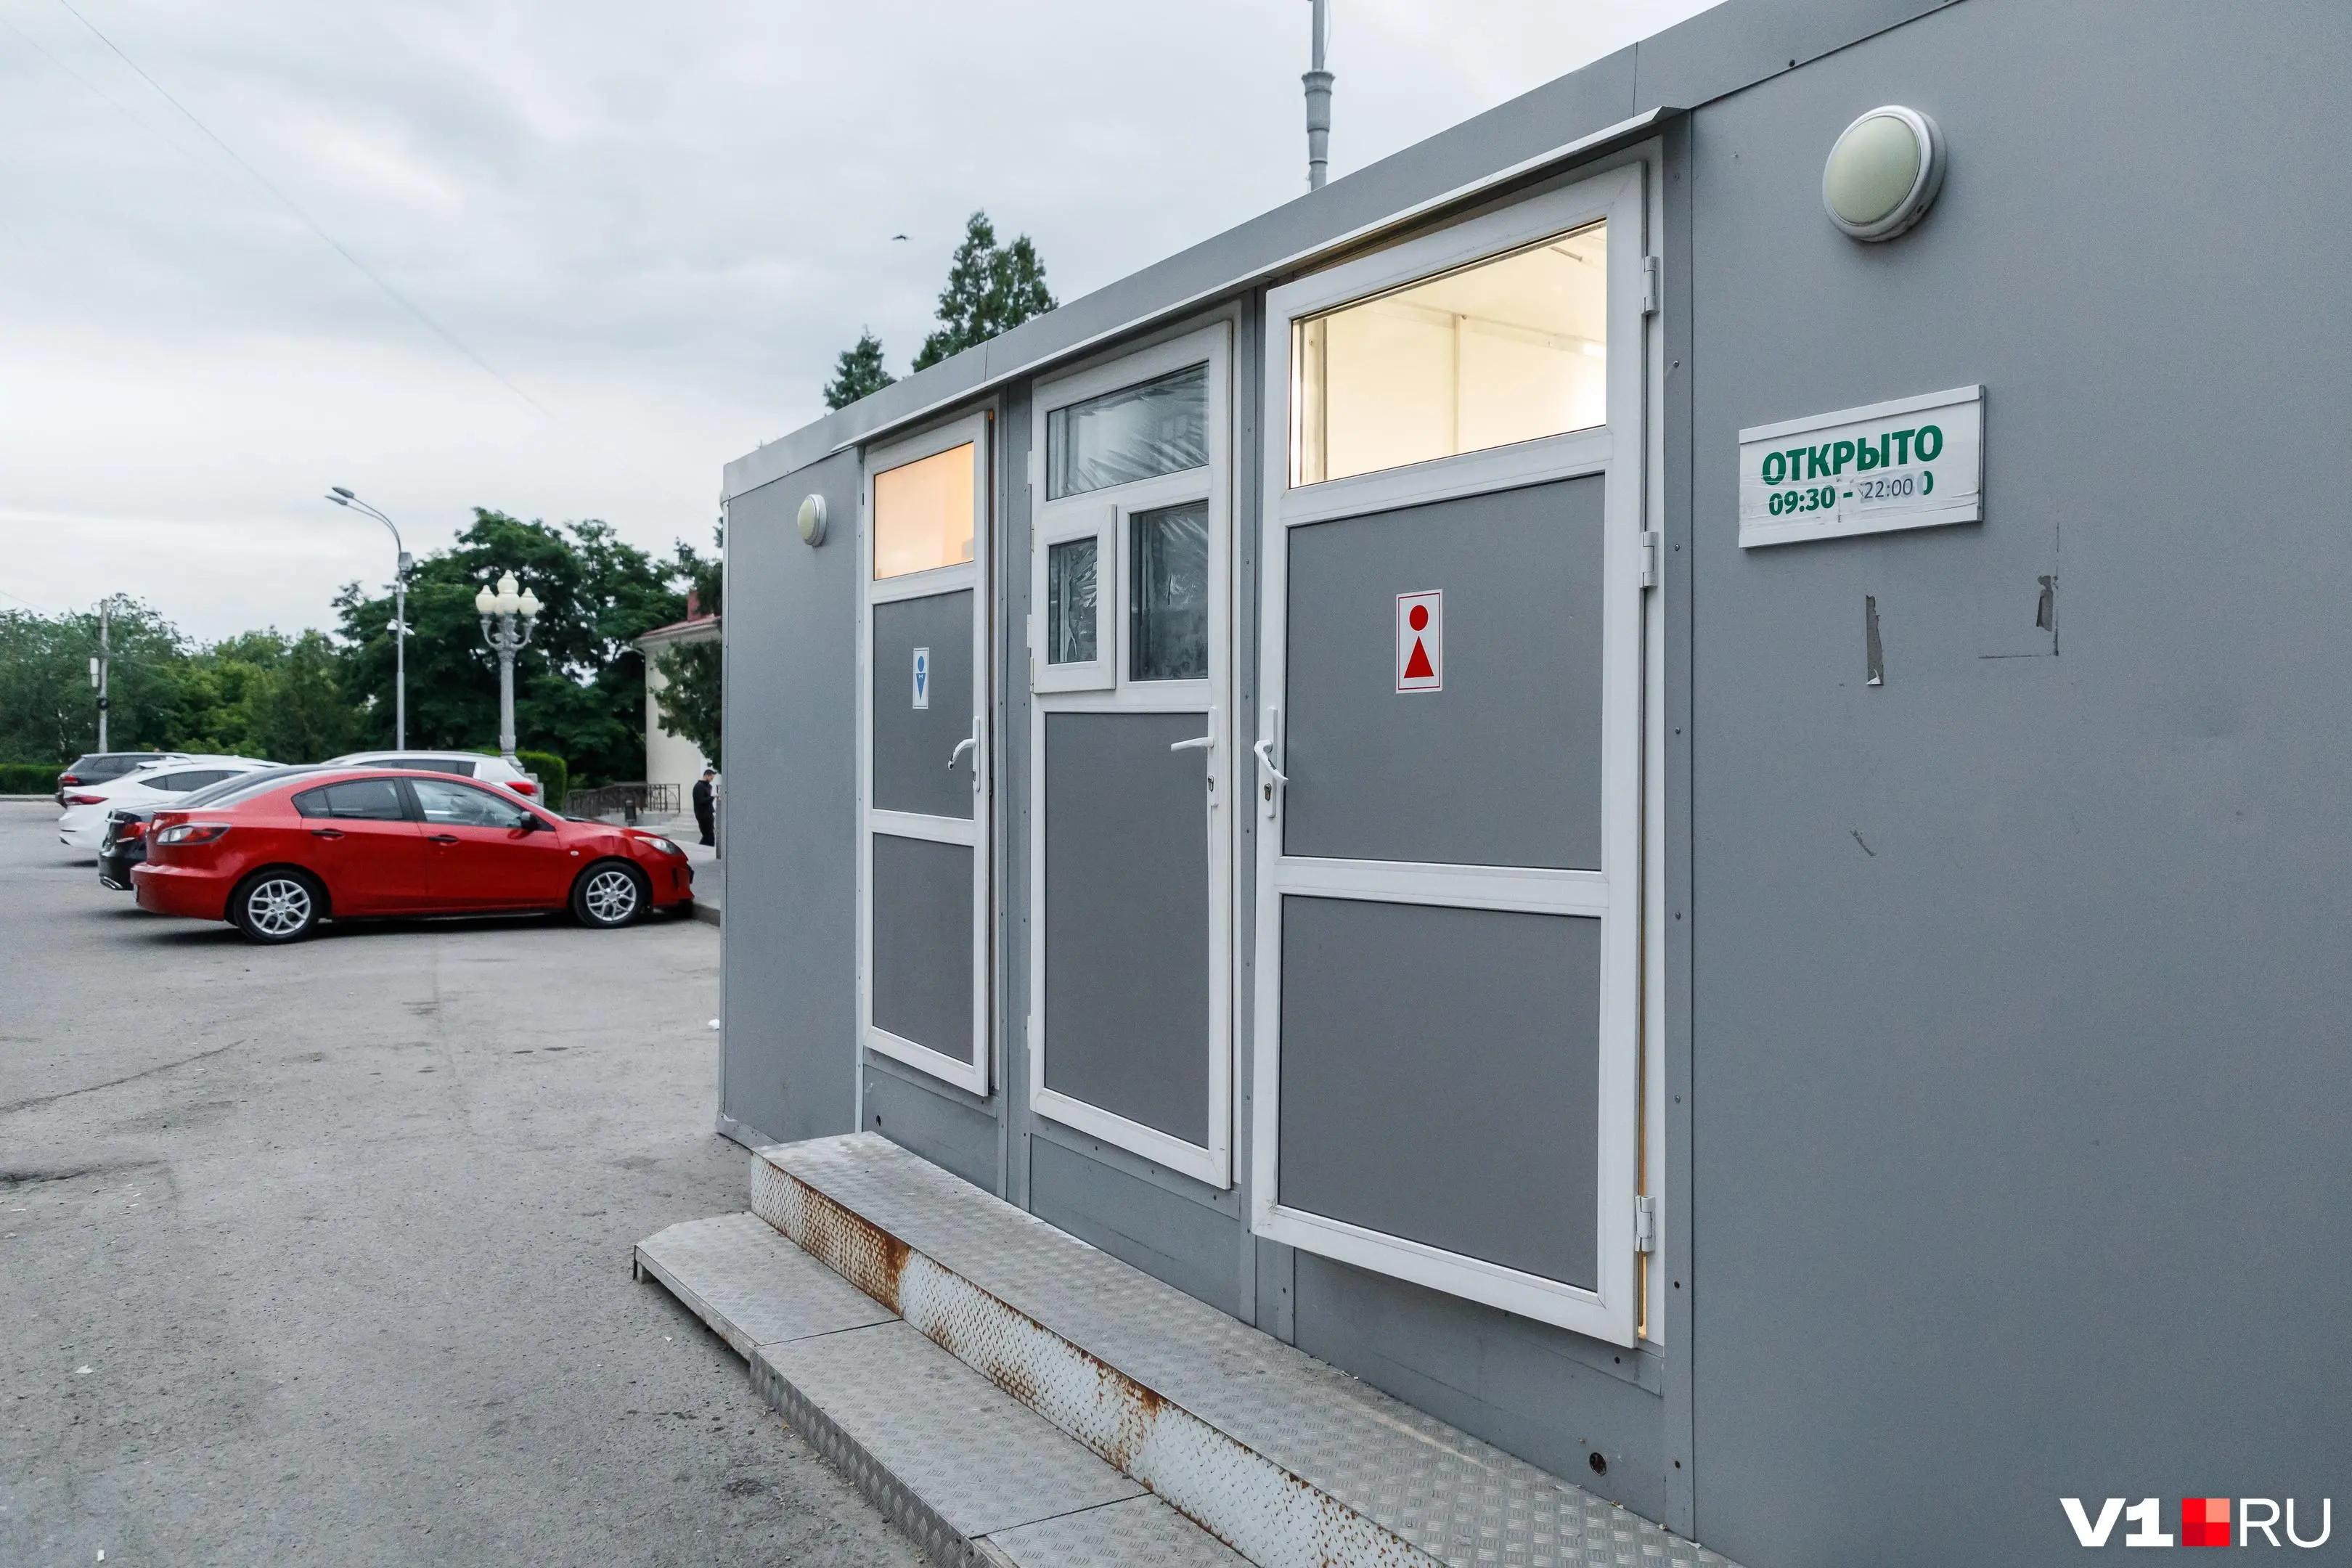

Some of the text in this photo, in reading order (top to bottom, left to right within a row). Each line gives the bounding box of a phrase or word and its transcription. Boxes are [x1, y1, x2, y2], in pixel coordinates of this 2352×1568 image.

[1762, 425, 1943, 486] ОТКРЫТО
[1768, 485, 1836, 516] 09:30
[1863, 478, 1914, 499] 22:00
